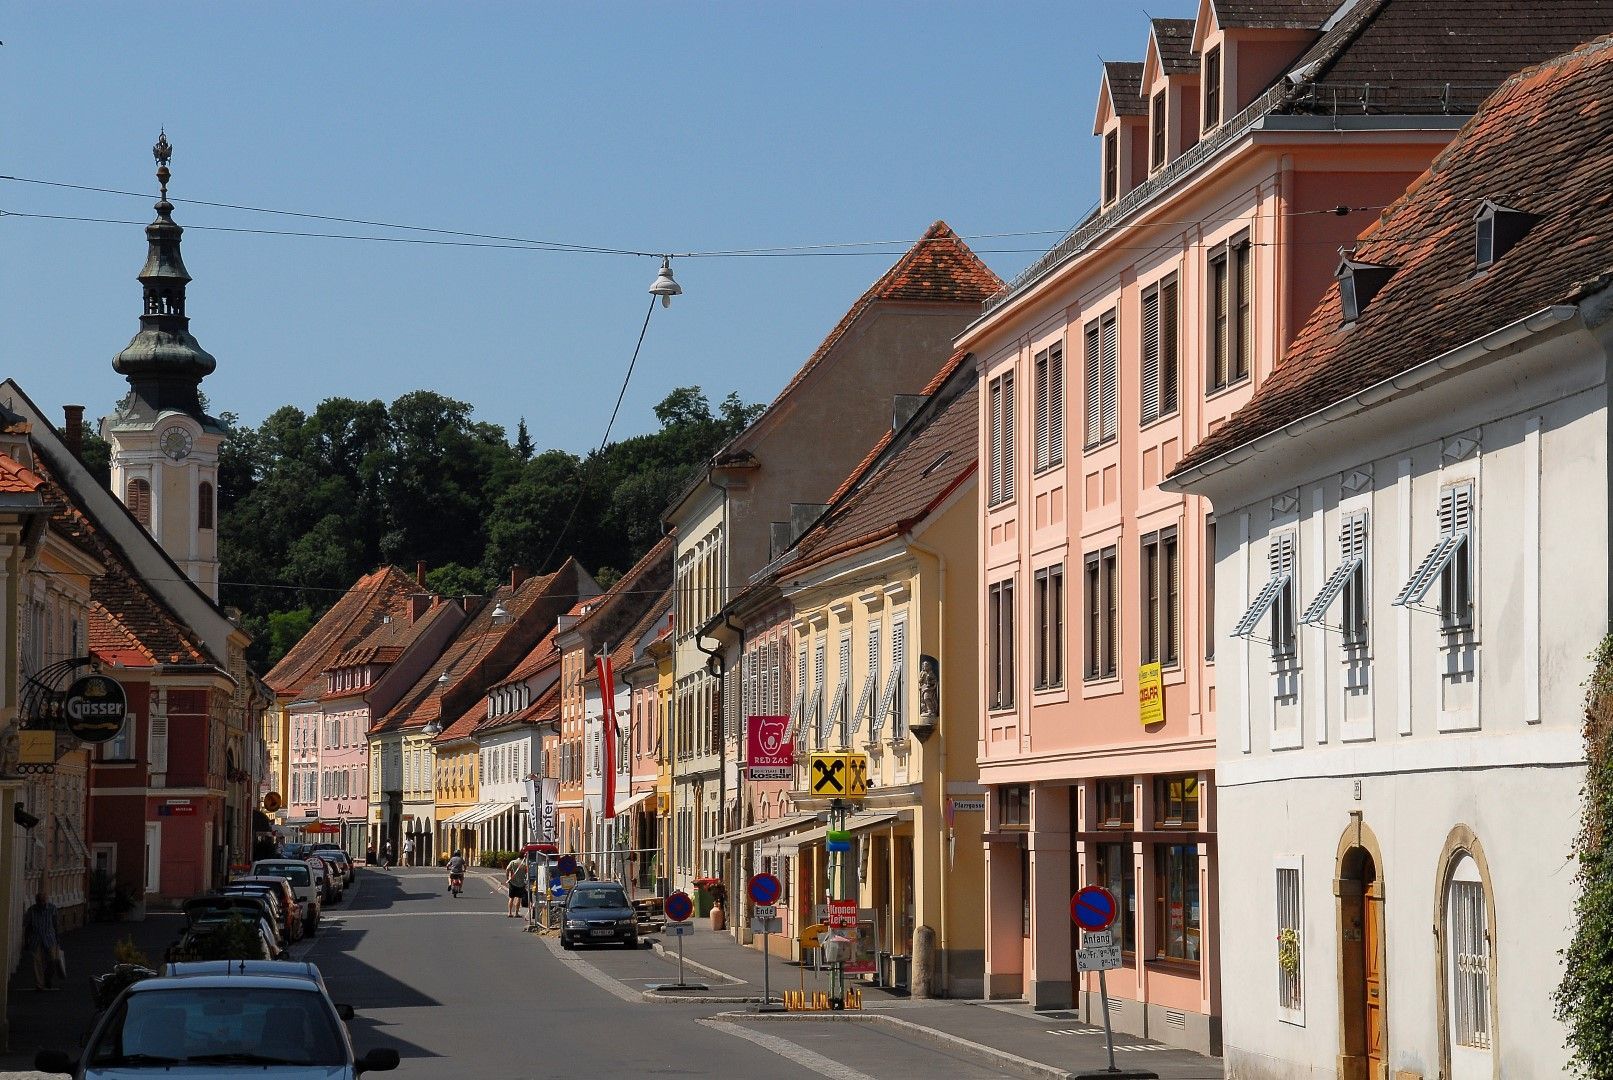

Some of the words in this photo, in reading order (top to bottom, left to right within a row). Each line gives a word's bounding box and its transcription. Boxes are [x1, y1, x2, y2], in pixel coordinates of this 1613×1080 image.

[68, 696, 122, 719] Gösser
[754, 756, 770, 764] RED
[772, 756, 788, 764] ZAC
[756, 907, 773, 915] Ende
[830, 904, 856, 914] Kronen
[1083, 934, 1110, 944] Anfang
[1078, 961, 1088, 969] Sa.
